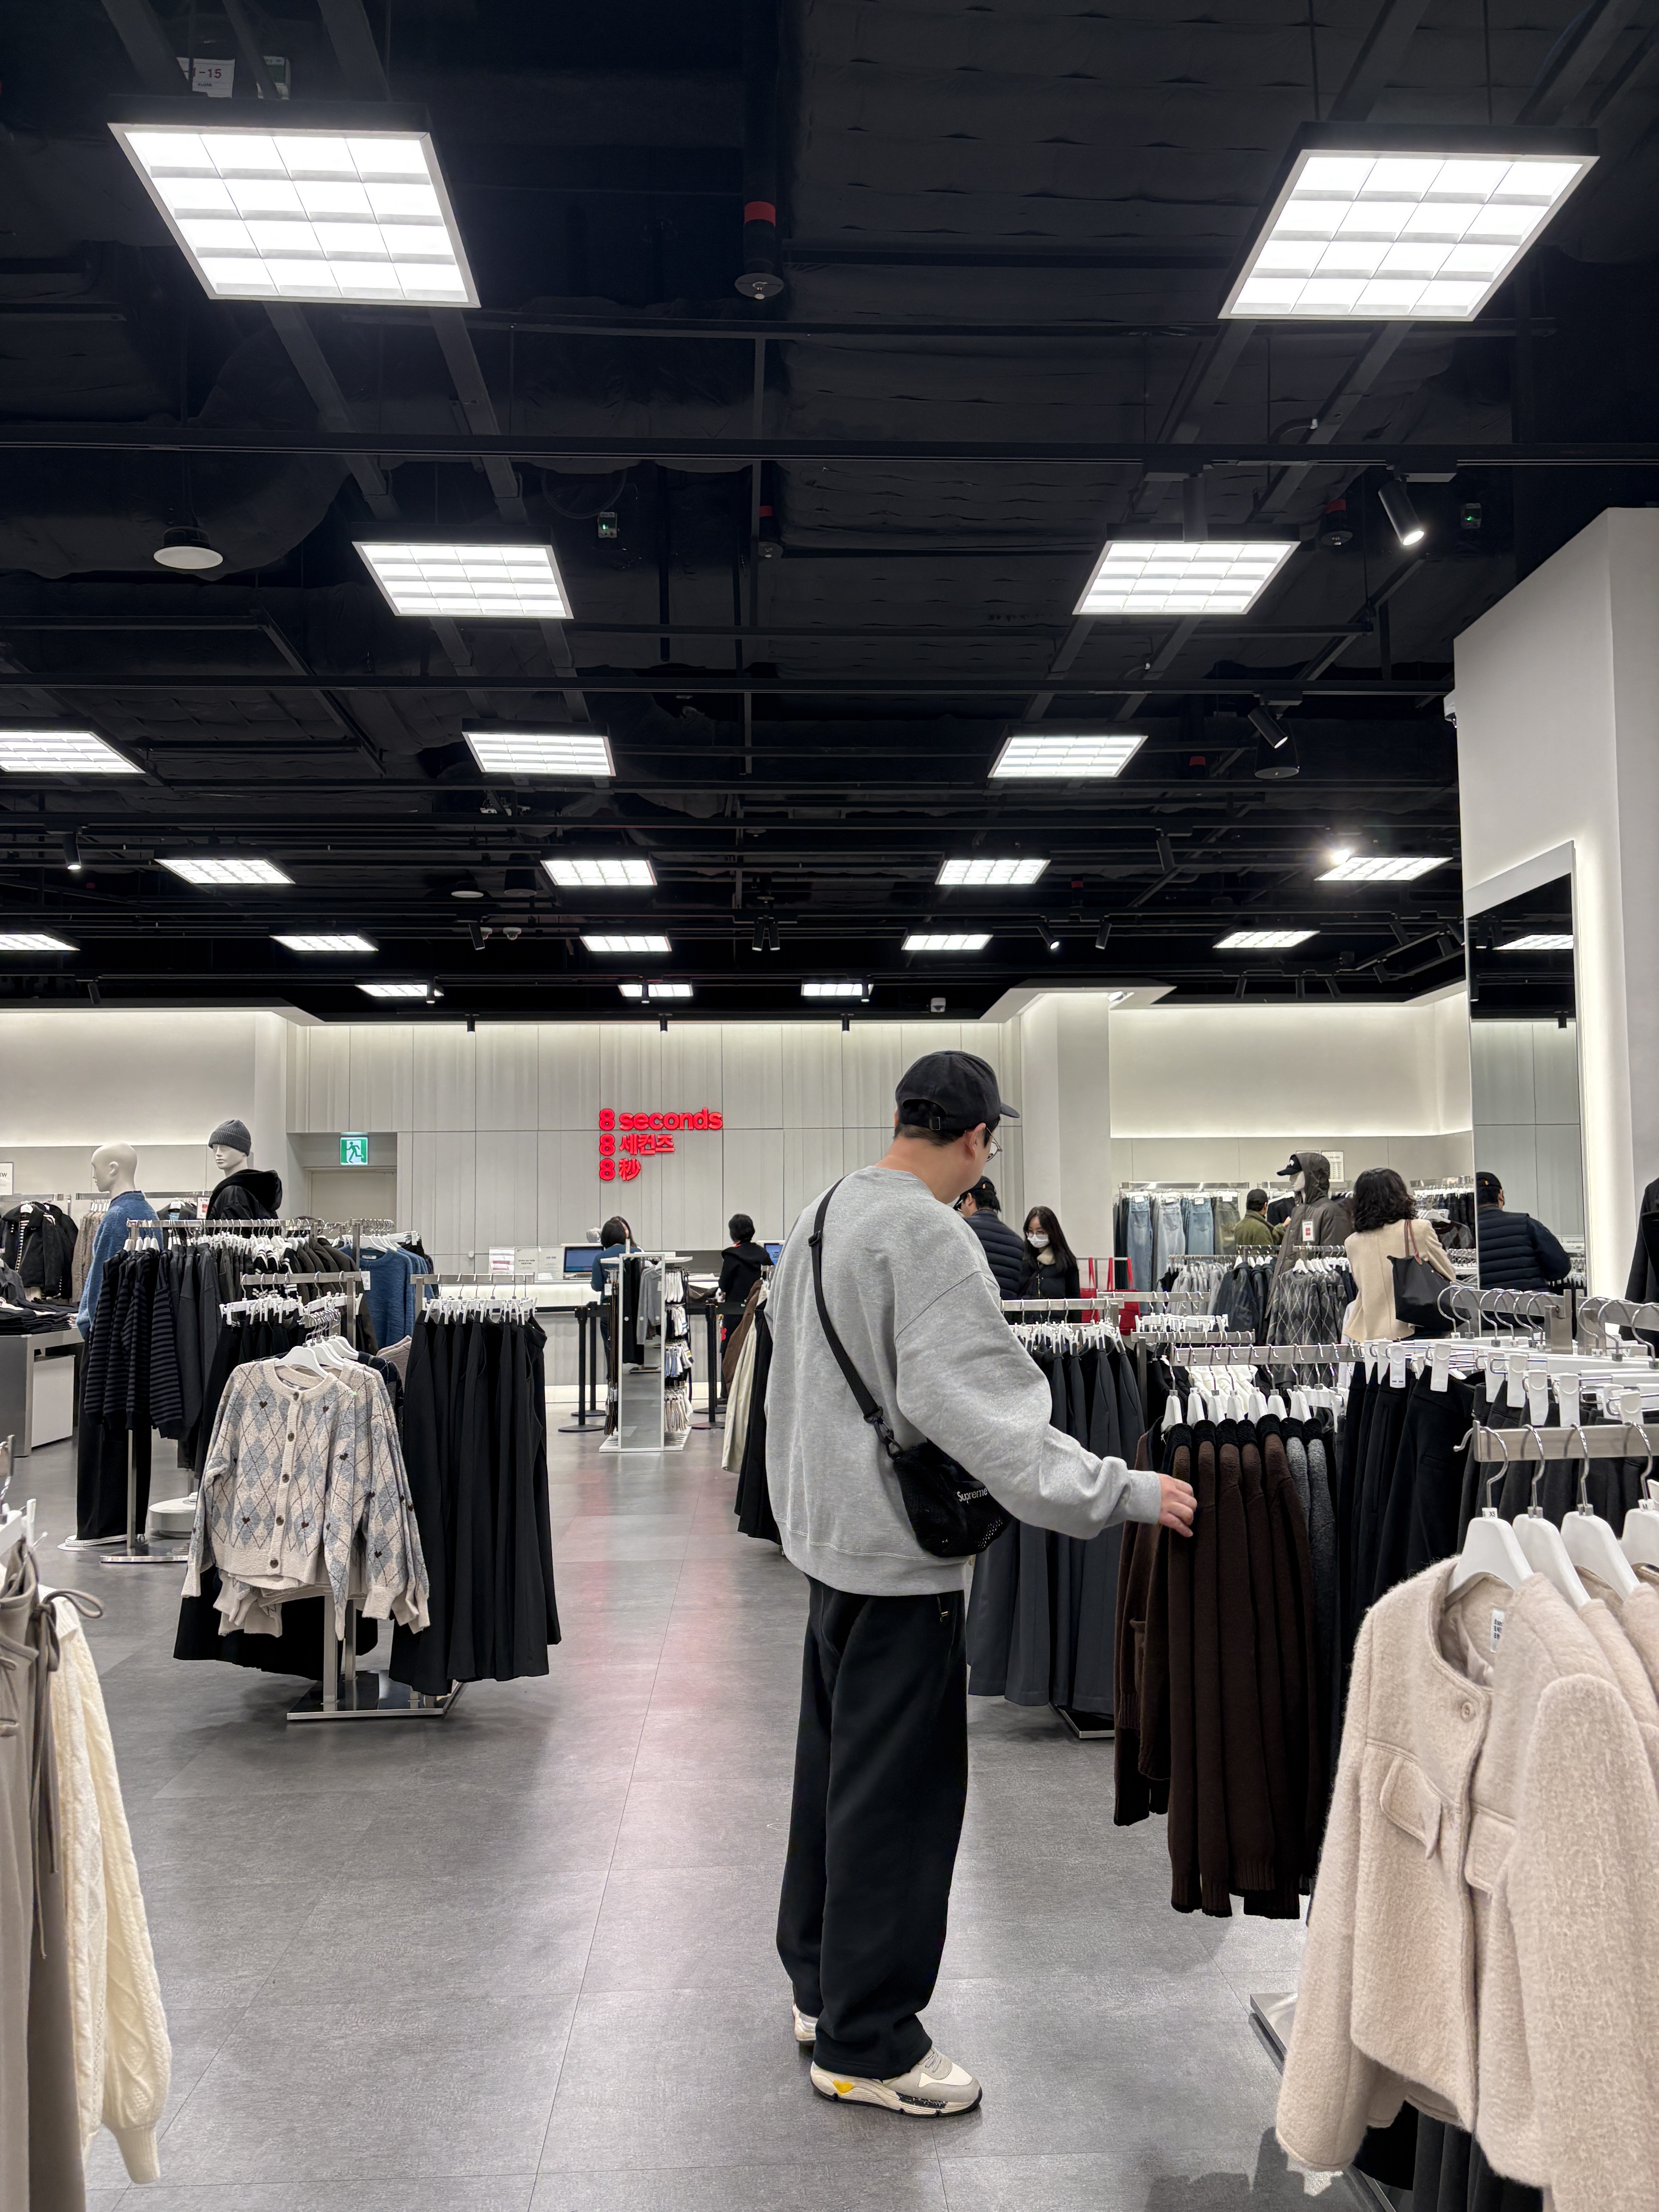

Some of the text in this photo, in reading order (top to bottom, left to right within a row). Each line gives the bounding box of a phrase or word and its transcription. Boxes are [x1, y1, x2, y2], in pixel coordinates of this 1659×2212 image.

[599, 1107, 723, 1130] 8 seconds
[599, 1133, 675, 1156] 8 세컨즈
[599, 1158, 641, 1181] 8 秒
[957, 1487, 988, 1504] Supreme
